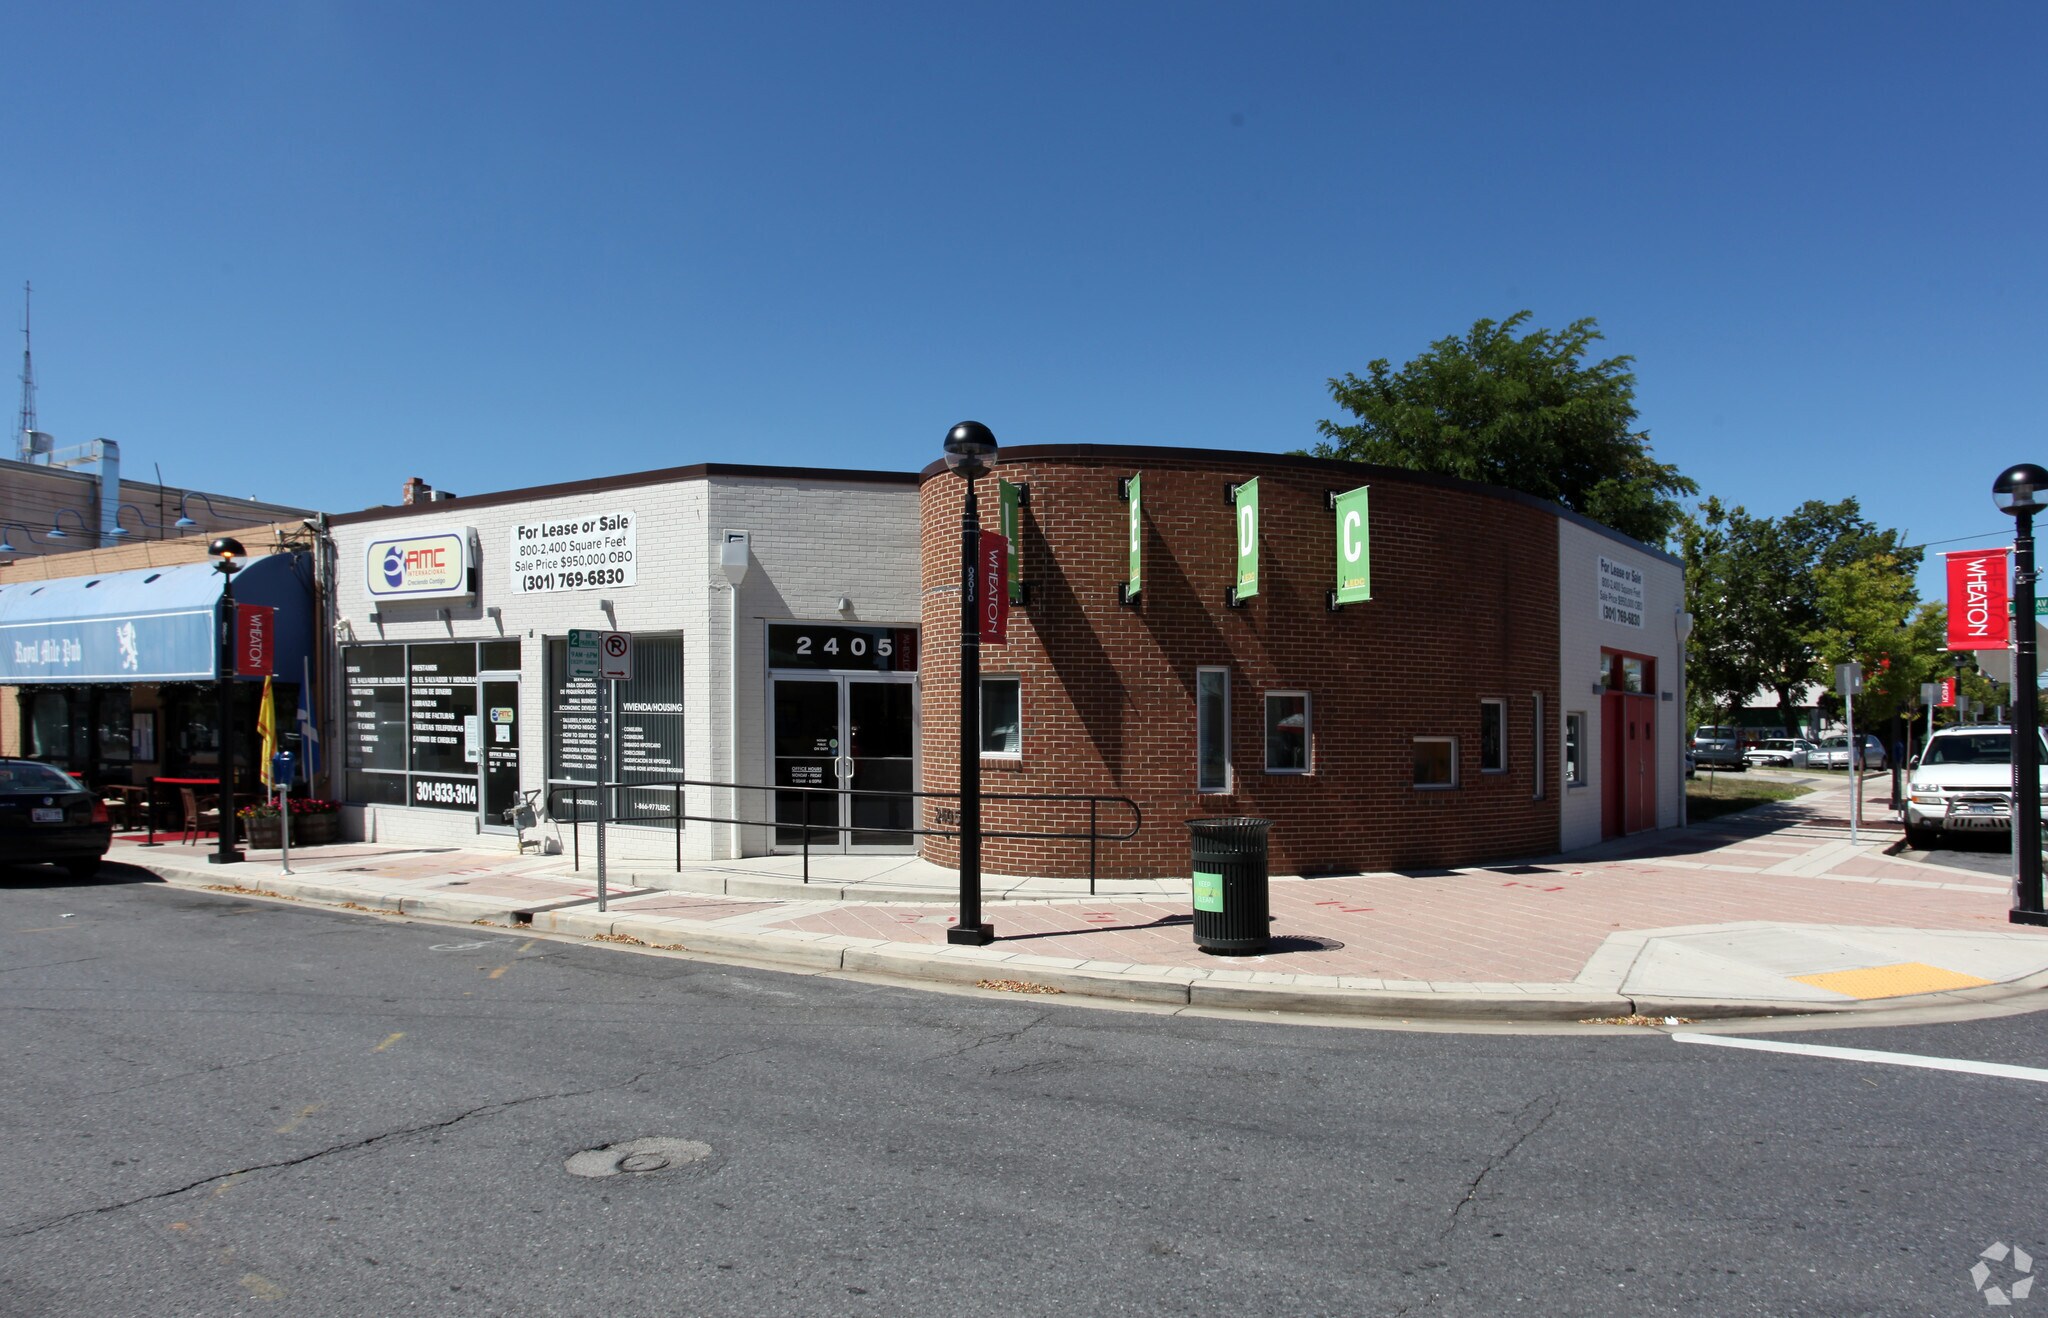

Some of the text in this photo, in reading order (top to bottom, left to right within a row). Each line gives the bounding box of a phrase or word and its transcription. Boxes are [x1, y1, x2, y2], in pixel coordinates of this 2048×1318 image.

[518, 514, 628, 540] For Lease or Sale
[1132, 498, 1138, 552] E
[1241, 505, 1253, 558] D
[520, 536, 626, 556] 800-2,400 Square Feet
[1344, 511, 1361, 562] C
[406, 548, 445, 570] AMC
[515, 550, 632, 572] Sale Price $950,000 OBO
[1601, 559, 1610, 573] For
[1610, 562, 1624, 579] Lease
[408, 569, 446, 577] INTERNACIONAL
[523, 568, 624, 592] (301) 769-6830
[988, 550, 998, 633] WHEATON
[1966, 558, 1988, 636] WHEATON
[249, 614, 262, 668] WHEATON
[570, 632, 578, 645] 2
[796, 636, 892, 656] 2405
[623, 702, 682, 712] VIVIENDA/HOUSING
[416, 781, 476, 804] 301-933-3114
[634, 802, 670, 811] 1-866-977LEDC
